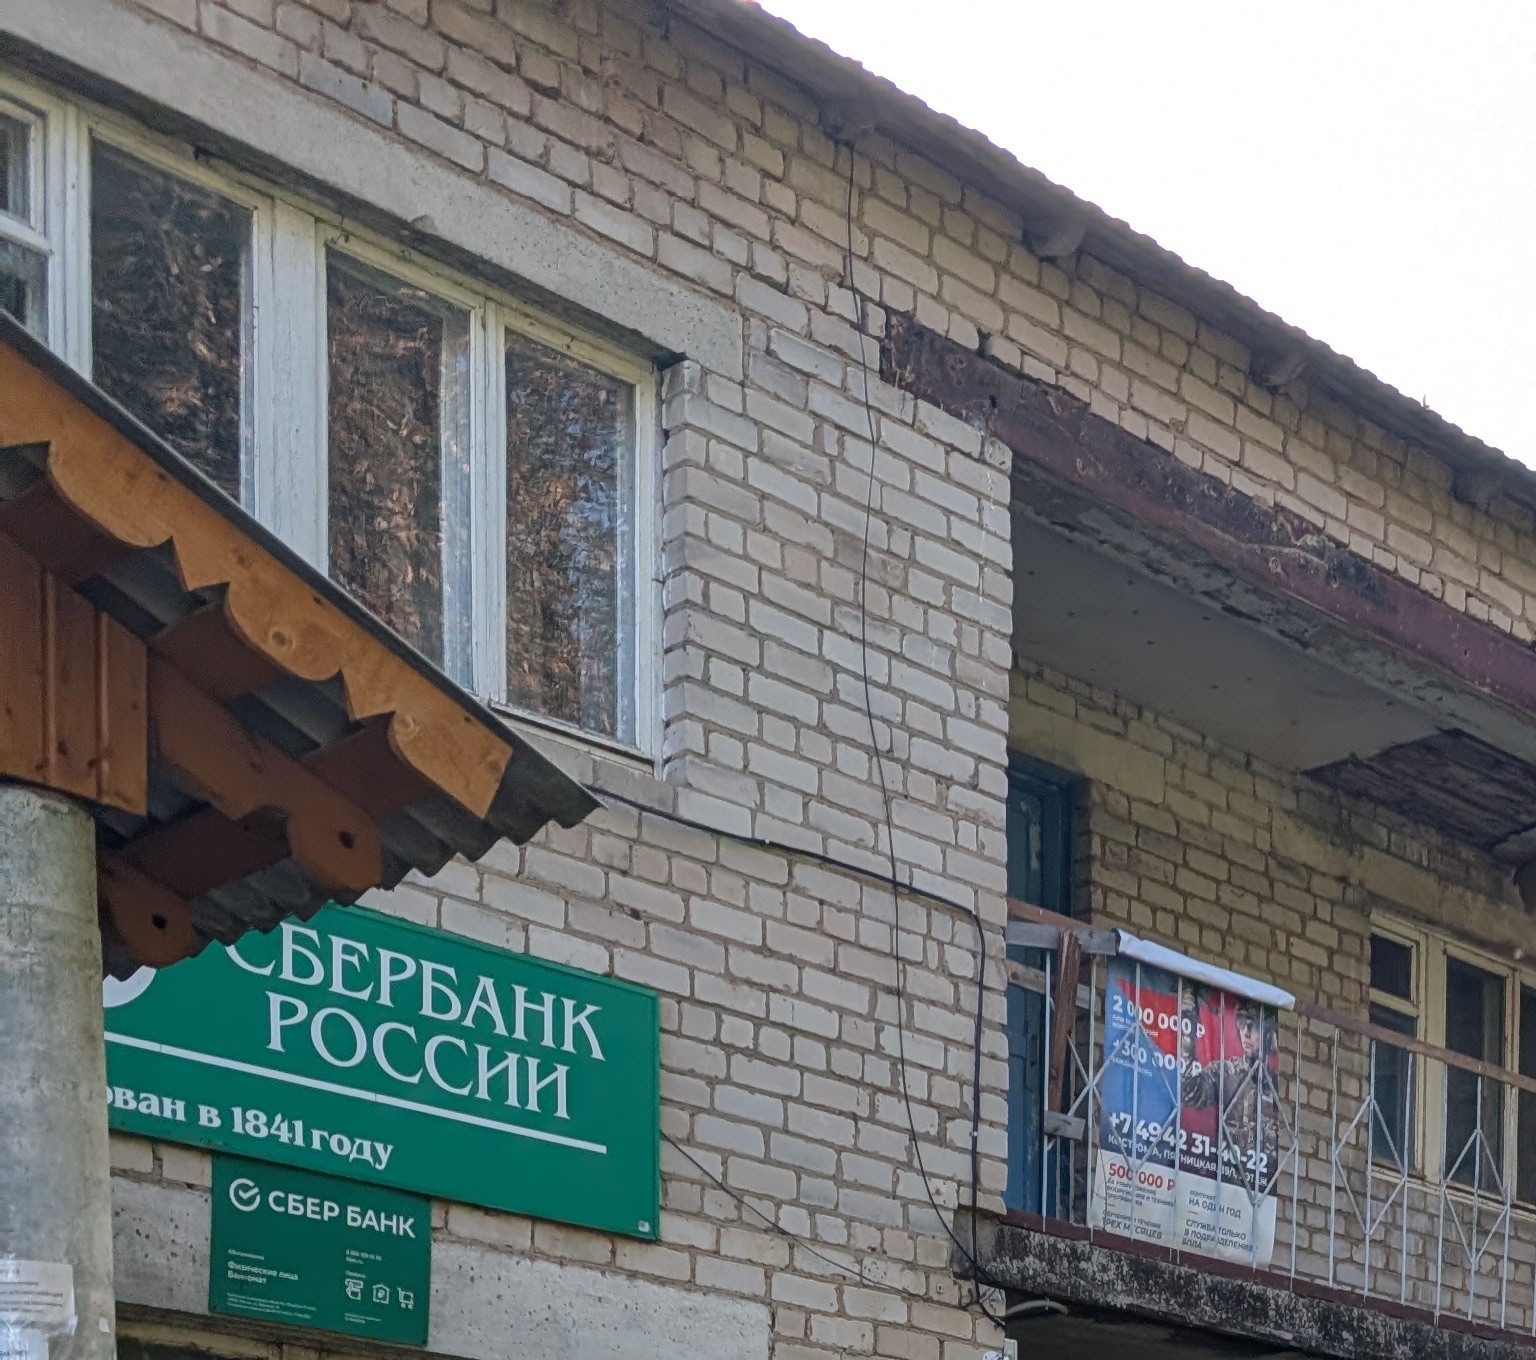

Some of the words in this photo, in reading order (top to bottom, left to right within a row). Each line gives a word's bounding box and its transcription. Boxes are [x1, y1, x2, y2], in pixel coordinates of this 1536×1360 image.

[1113, 995, 1123, 1013] 2
[1157, 1012, 1191, 1035] 000
[265, 991, 570, 1120] РОССИИ
[106, 1085, 186, 1122] ван
[198, 1104, 222, 1128] в
[231, 1106, 305, 1148] 1841
[311, 1129, 393, 1170] году
[1136, 1120, 1187, 1150] 4942
[1190, 1132, 1268, 1174] 31-40-22
[1108, 1133, 1162, 1159] КСТОА,
[1163, 1149, 1217, 1172] ПЯНИЦКАЯ
[1138, 1171, 1163, 1189] 000
[268, 1190, 340, 1221] СБЕР
[346, 1205, 416, 1238] БАНК
[1123, 1222, 1163, 1239] МСЯЦЕВ
